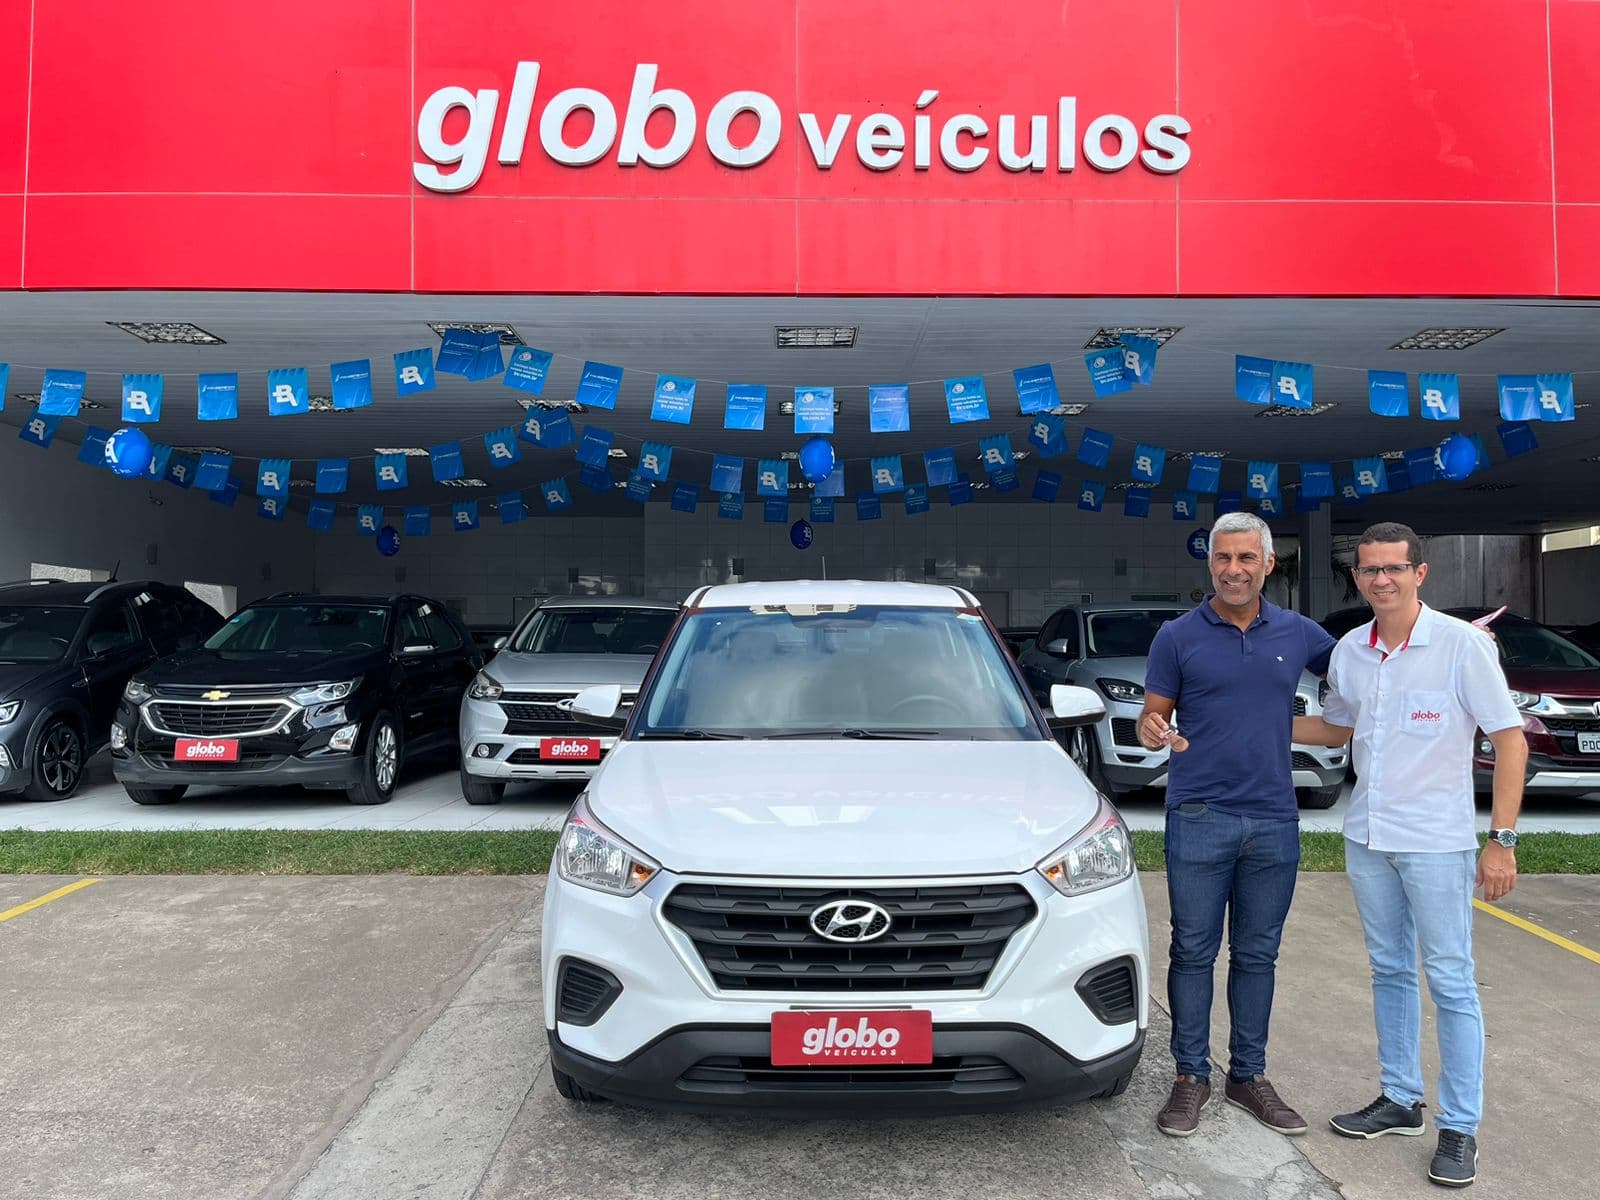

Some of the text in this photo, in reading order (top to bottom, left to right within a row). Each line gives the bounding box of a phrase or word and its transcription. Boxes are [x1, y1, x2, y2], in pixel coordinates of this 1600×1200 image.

[413, 62, 1193, 192] globo veículos
[1411, 710, 1440, 721] globo
[186, 741, 226, 758] globo
[551, 740, 589, 756] globo
[803, 1018, 900, 1055] globo
